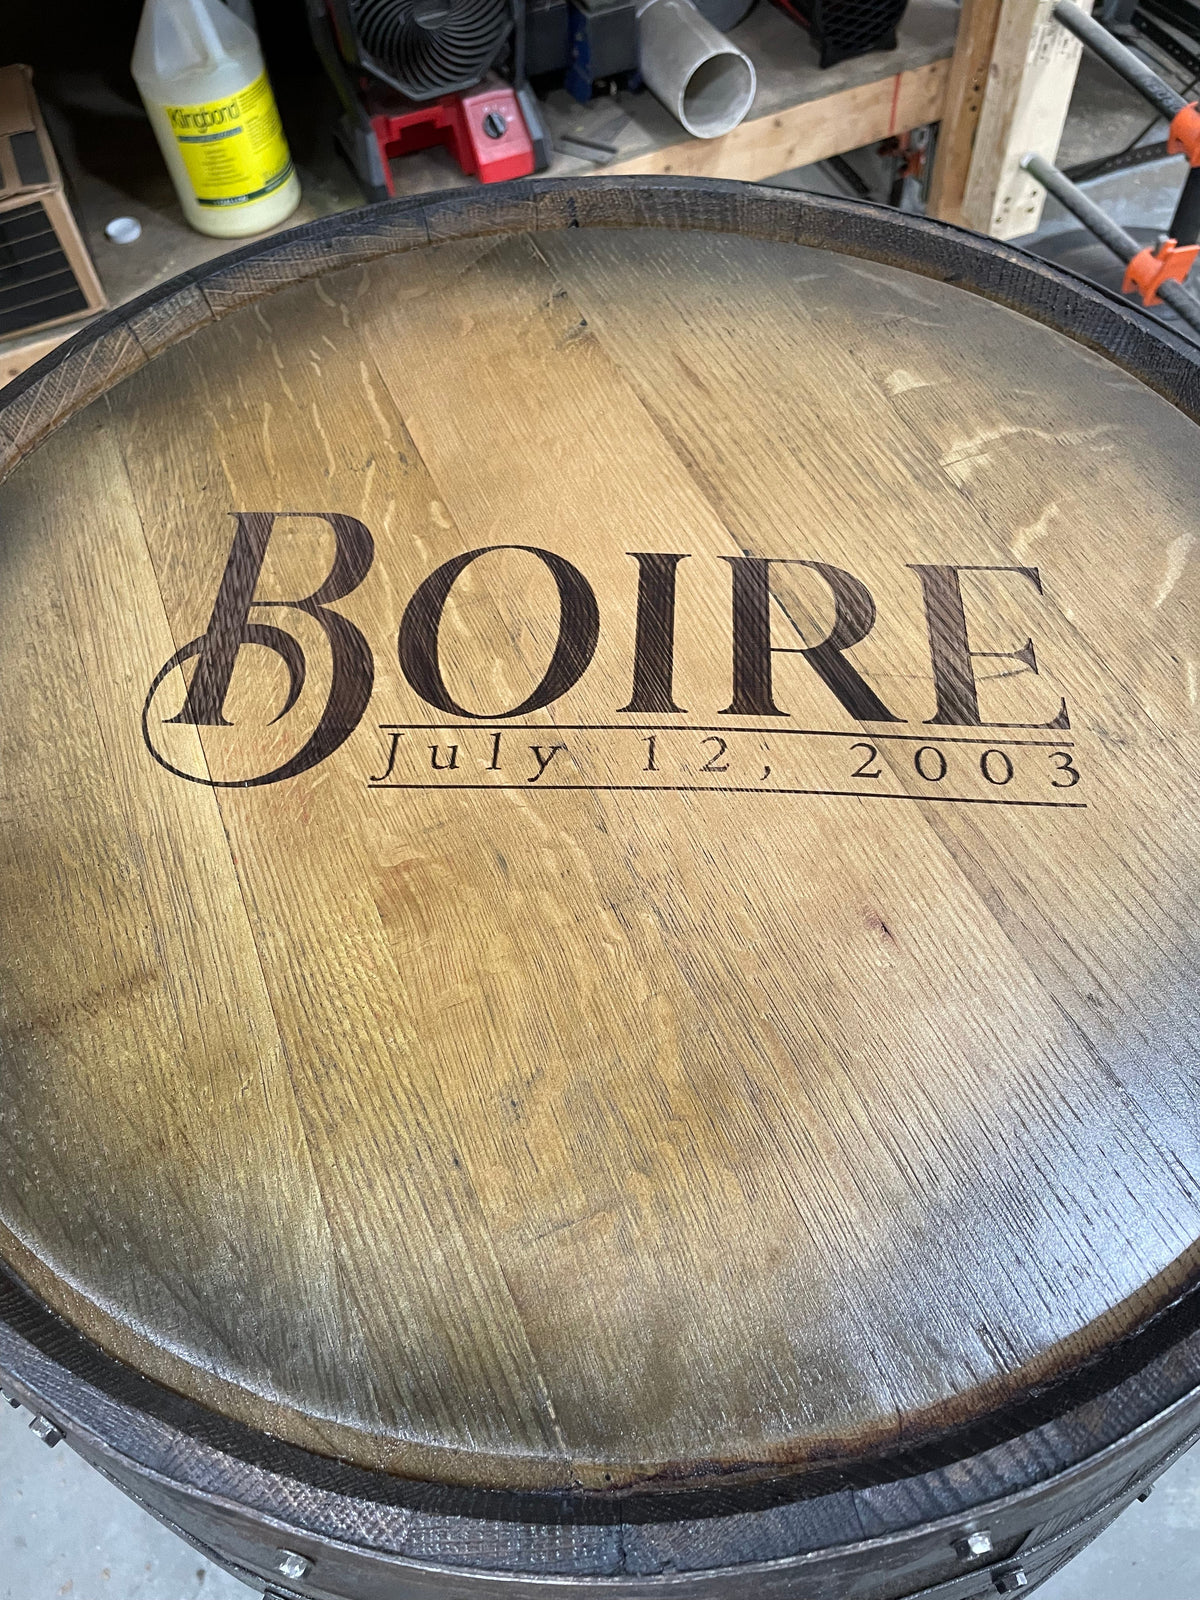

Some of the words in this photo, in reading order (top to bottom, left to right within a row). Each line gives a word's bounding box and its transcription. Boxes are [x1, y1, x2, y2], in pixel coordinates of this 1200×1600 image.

[142, 512, 1071, 788] BOIRE
[370, 733, 567, 782] July
[642, 735, 771, 781] 12,
[851, 742, 1080, 788] 2003
